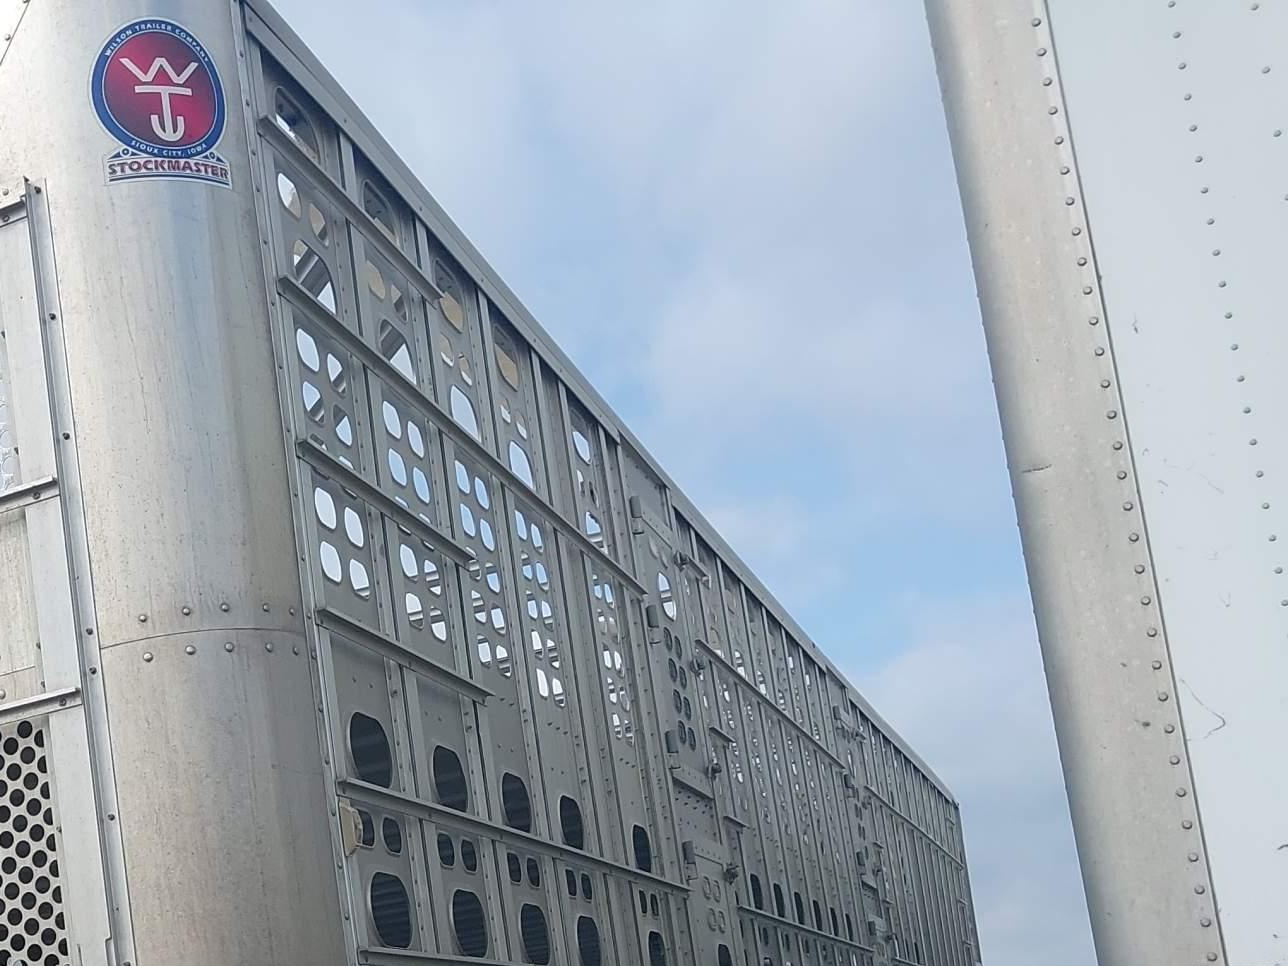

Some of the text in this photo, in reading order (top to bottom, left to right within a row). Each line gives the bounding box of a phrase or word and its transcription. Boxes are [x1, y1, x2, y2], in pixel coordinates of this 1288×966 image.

[105, 23, 209, 62] WILSON TRAILER COMPANY
[131, 140, 159, 154] SIOUX
[187, 143, 207, 156] IOWA
[108, 159, 229, 180] STOCKMASTER
